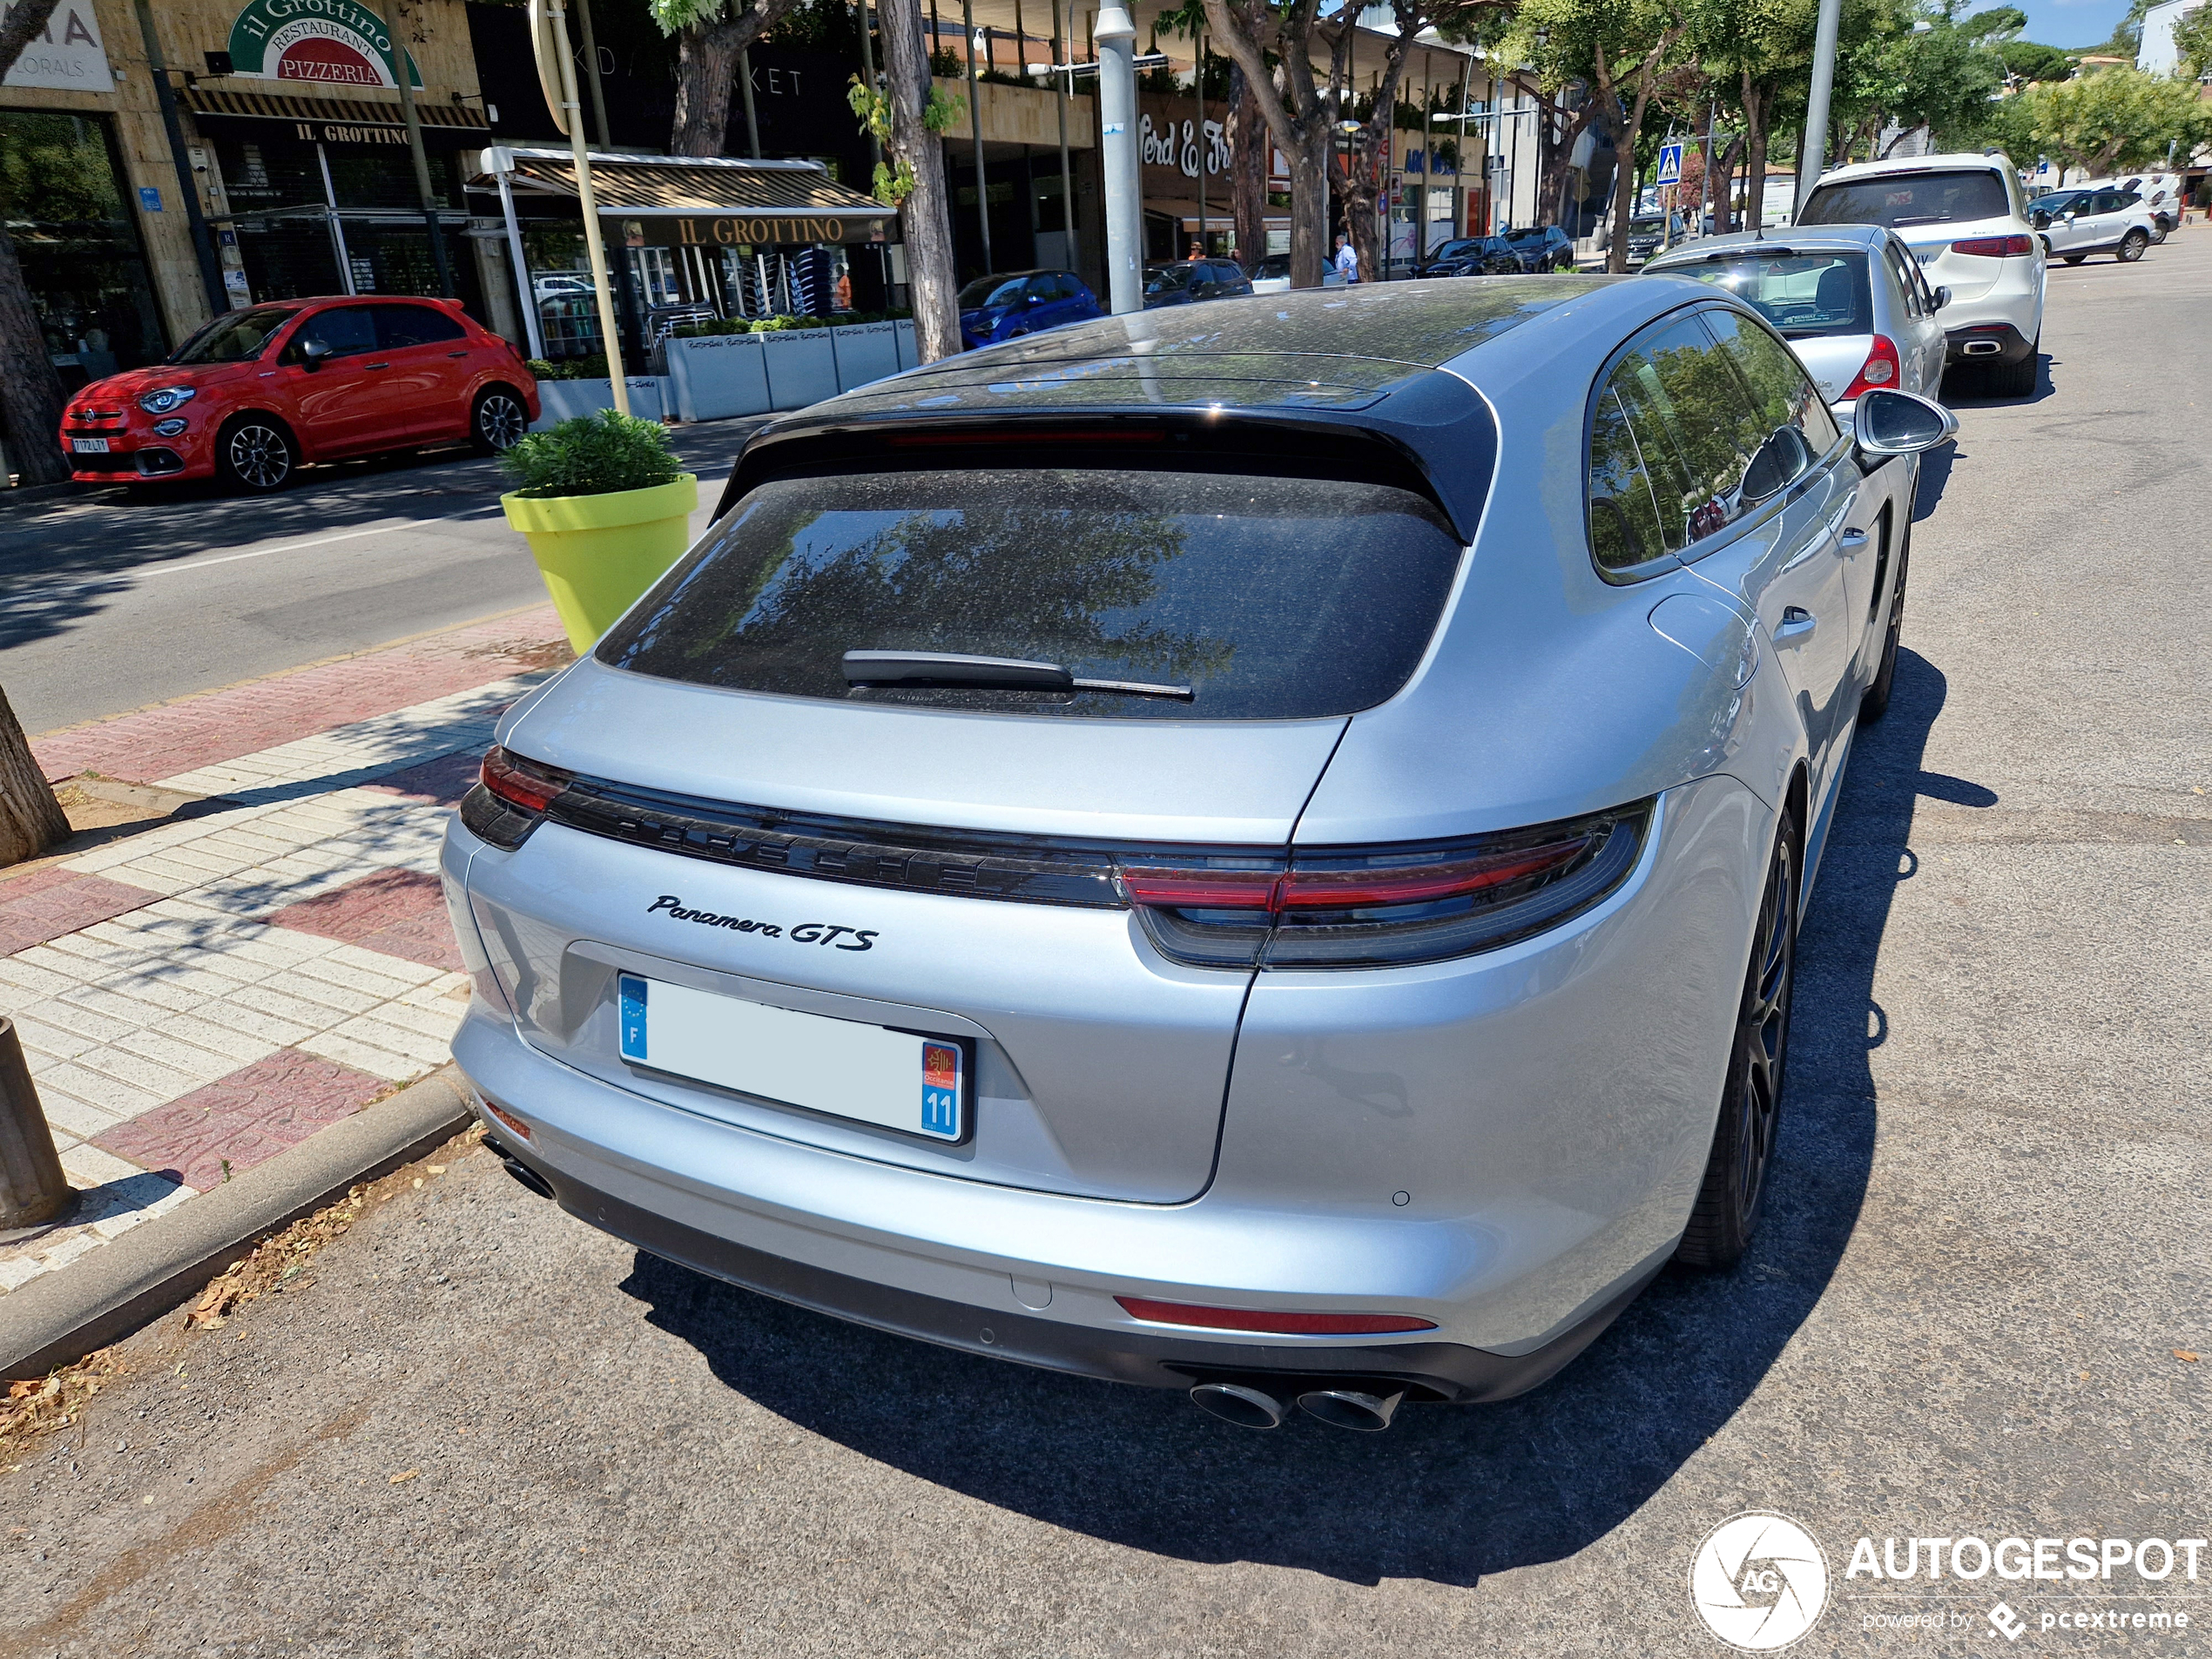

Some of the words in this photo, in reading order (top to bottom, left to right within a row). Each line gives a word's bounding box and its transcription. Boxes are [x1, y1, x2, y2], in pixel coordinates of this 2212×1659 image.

[243, 16, 270, 40] il
[273, 22, 374, 57] RESTAURANT
[280, 59, 381, 84] PIZZERIA
[296, 124, 316, 140] IL
[678, 219, 706, 244] IL
[713, 218, 844, 244] GROTTINO
[647, 894, 783, 939] Panamera
[790, 923, 880, 952] GTS
[630, 1027, 638, 1043] F
[925, 1075, 954, 1087] Occitanie
[927, 1092, 951, 1127] 11
